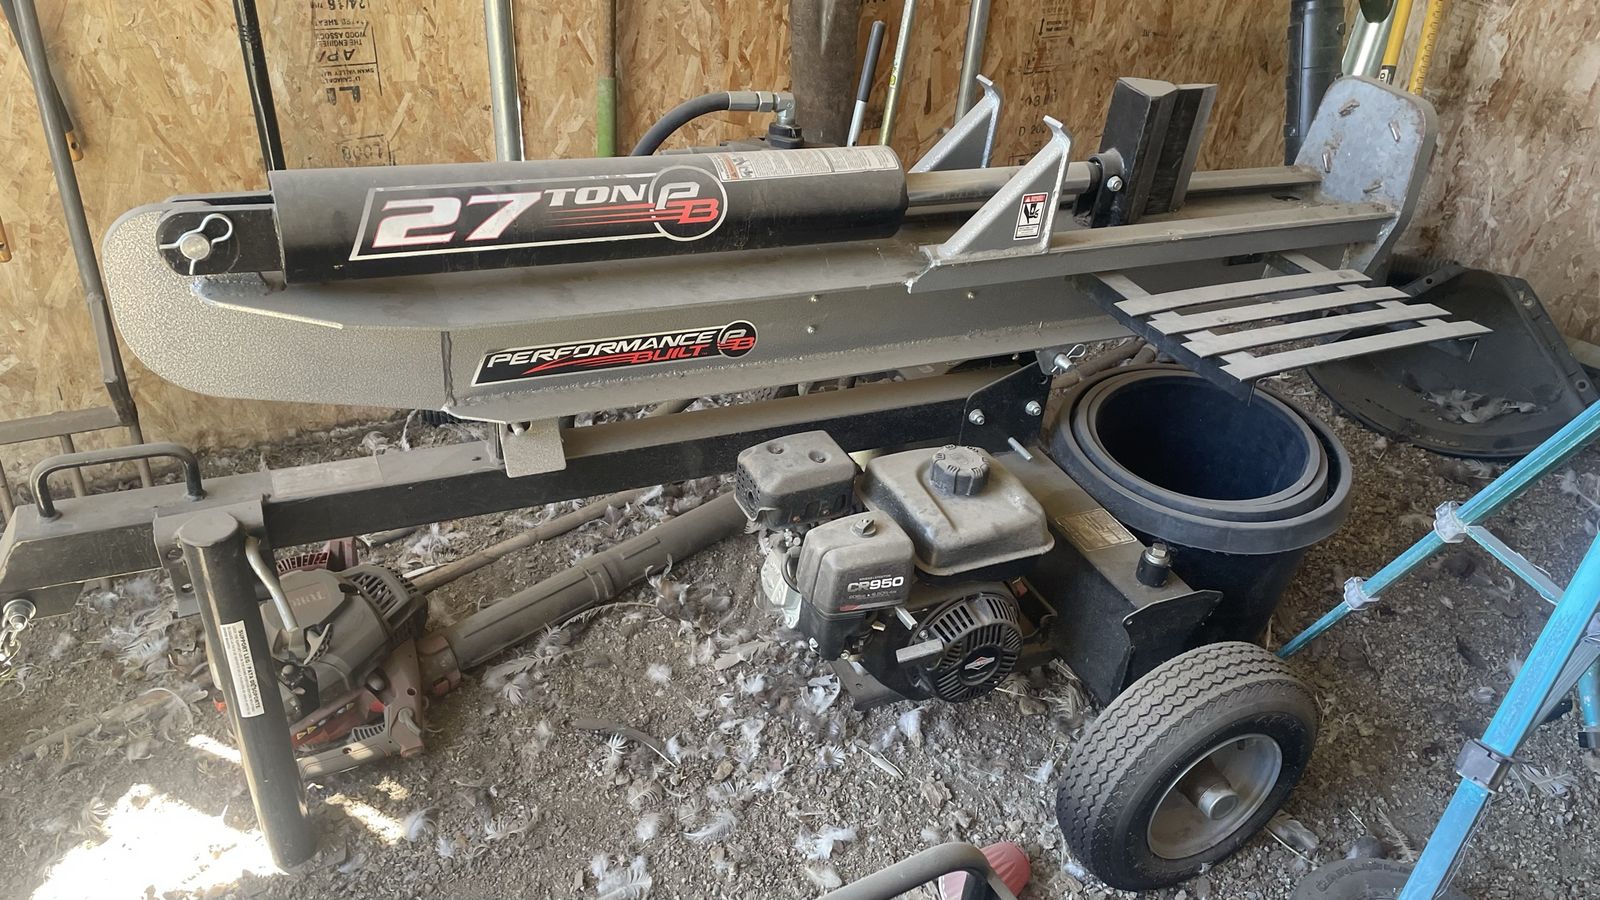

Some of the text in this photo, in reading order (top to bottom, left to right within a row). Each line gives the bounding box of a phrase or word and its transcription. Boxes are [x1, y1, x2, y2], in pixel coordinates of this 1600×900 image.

[372, 184, 649, 248] 27 TON
[486, 330, 718, 368] PERFORMANCE
[629, 344, 711, 364] BUILT
[847, 576, 904, 592] CR950
[238, 629, 248, 654] SUPPORT
[243, 653, 251, 663] LEG
[246, 666, 255, 680] PATA
